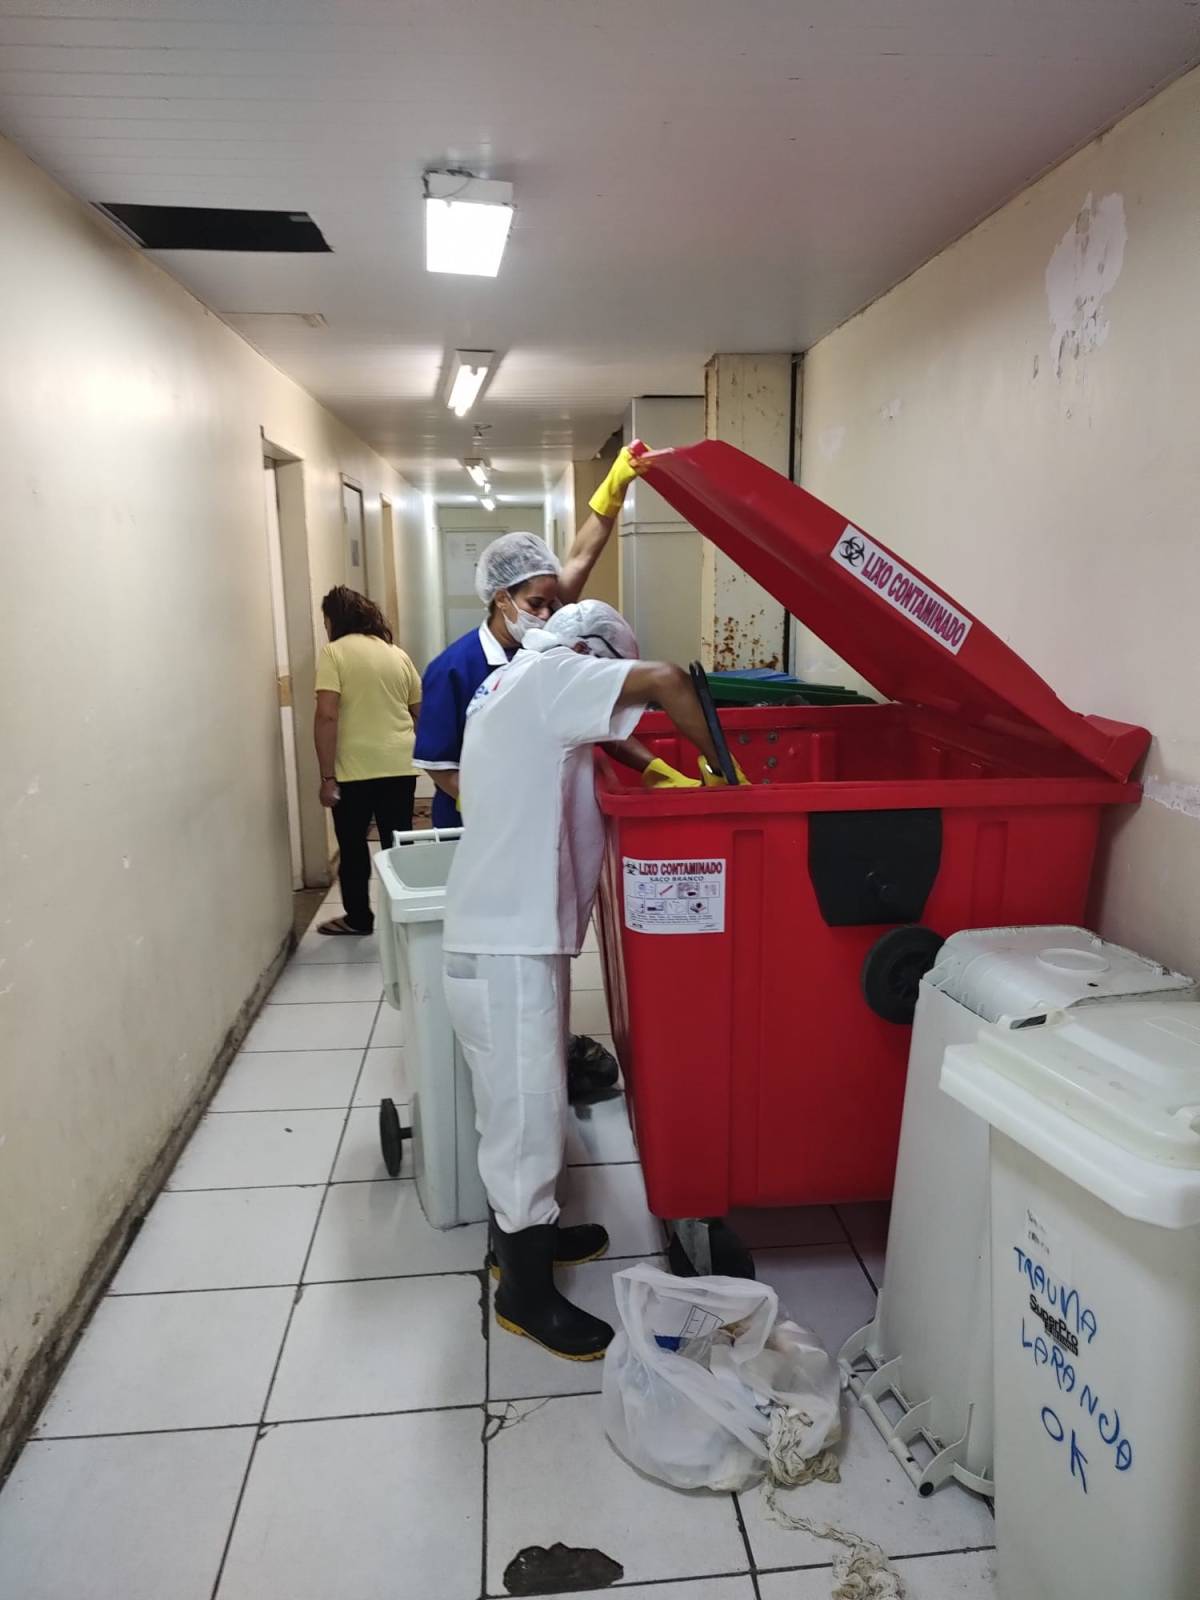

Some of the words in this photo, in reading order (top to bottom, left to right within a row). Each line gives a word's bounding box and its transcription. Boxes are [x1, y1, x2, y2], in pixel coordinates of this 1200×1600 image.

[861, 552, 893, 590] LIXO
[888, 573, 966, 647] CONTAMINADO
[639, 863, 658, 876] LIXO
[660, 862, 722, 876] CONTAMINADO
[1013, 1246, 1096, 1344] TRAUMA
[1041, 1406, 1088, 1494] OK
